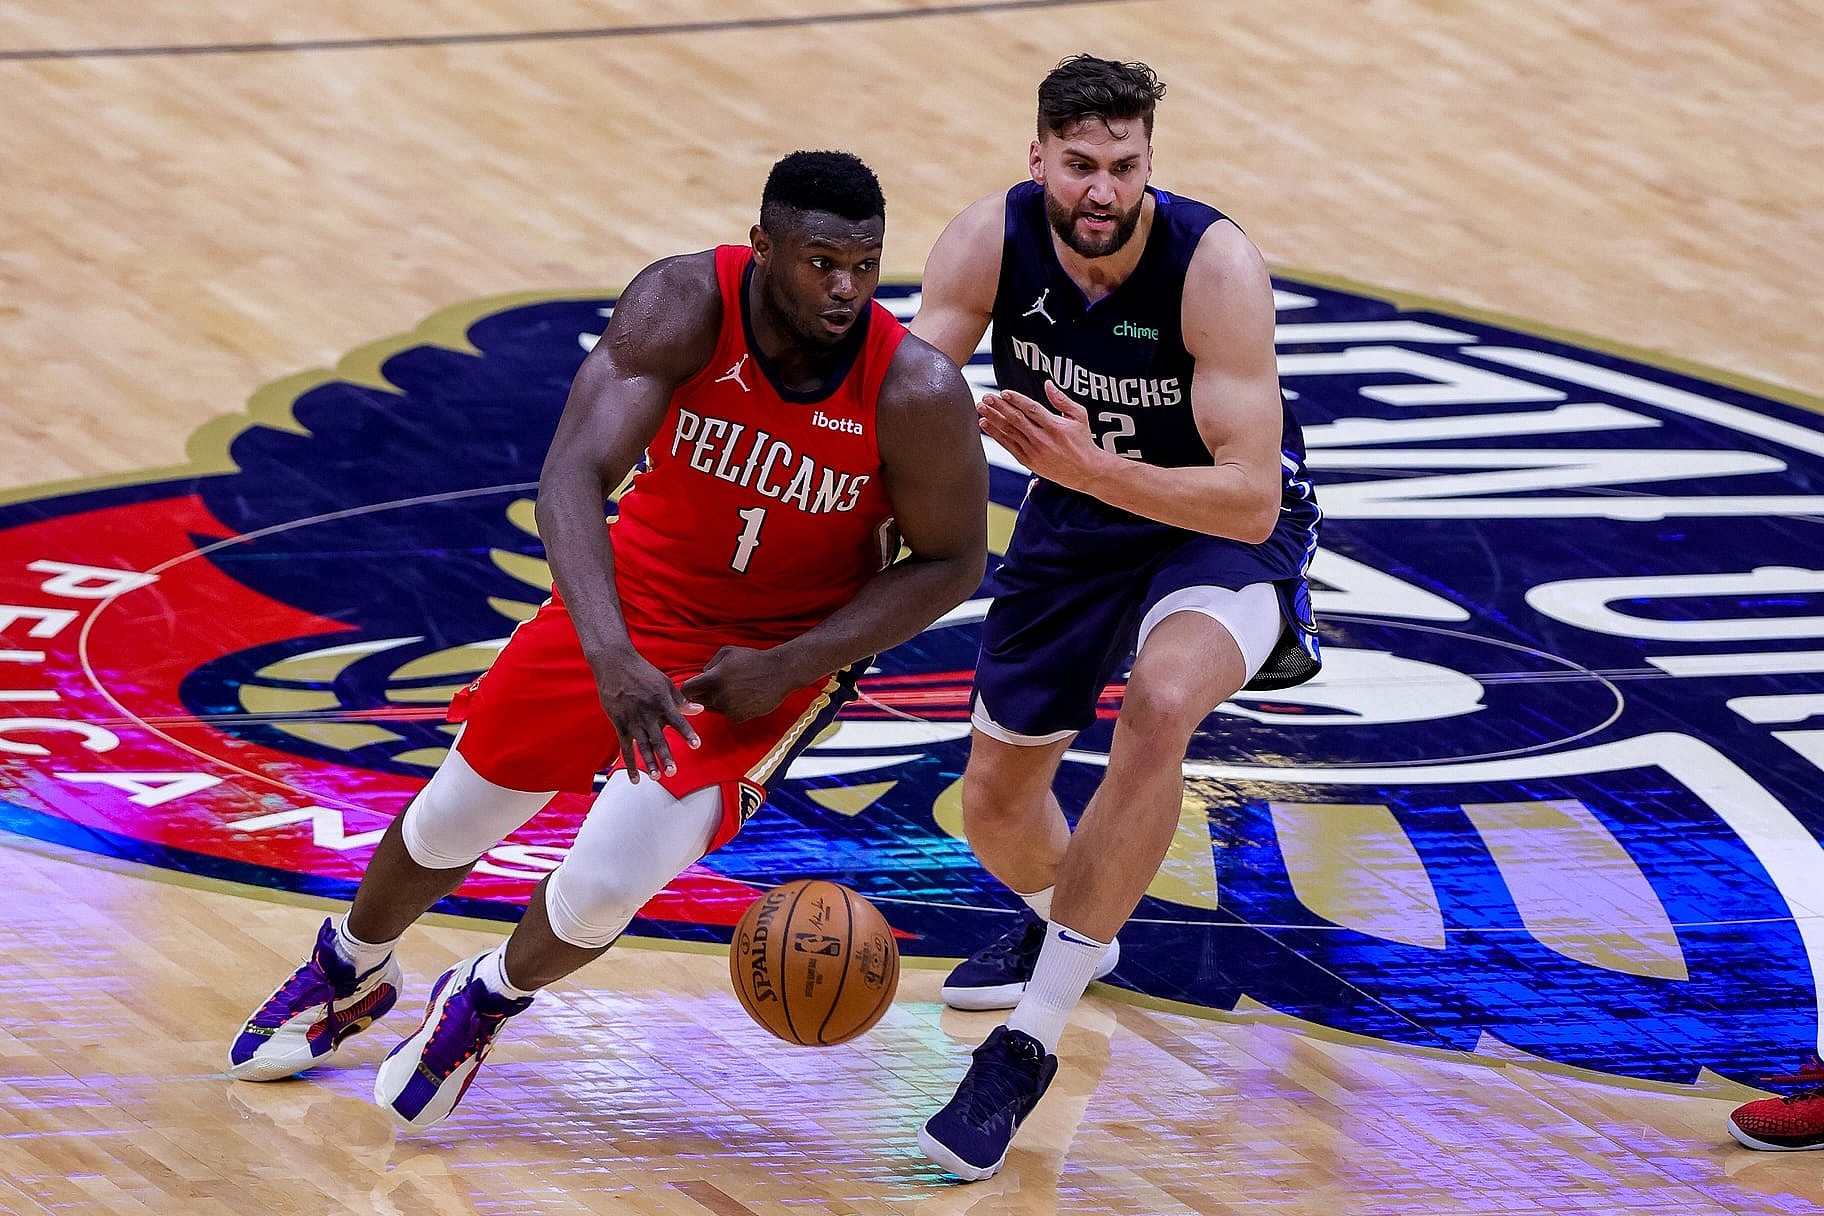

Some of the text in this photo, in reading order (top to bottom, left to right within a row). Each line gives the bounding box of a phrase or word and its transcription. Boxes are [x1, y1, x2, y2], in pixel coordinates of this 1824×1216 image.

[1113, 320, 1159, 341] chime
[1011, 335, 1182, 408] MAVERICKS
[812, 411, 864, 435] ibotta
[1092, 411, 1142, 459] 2
[671, 408, 870, 514] PELICANS
[731, 507, 768, 573] 1
[751, 892, 790, 1003] SPALDING
